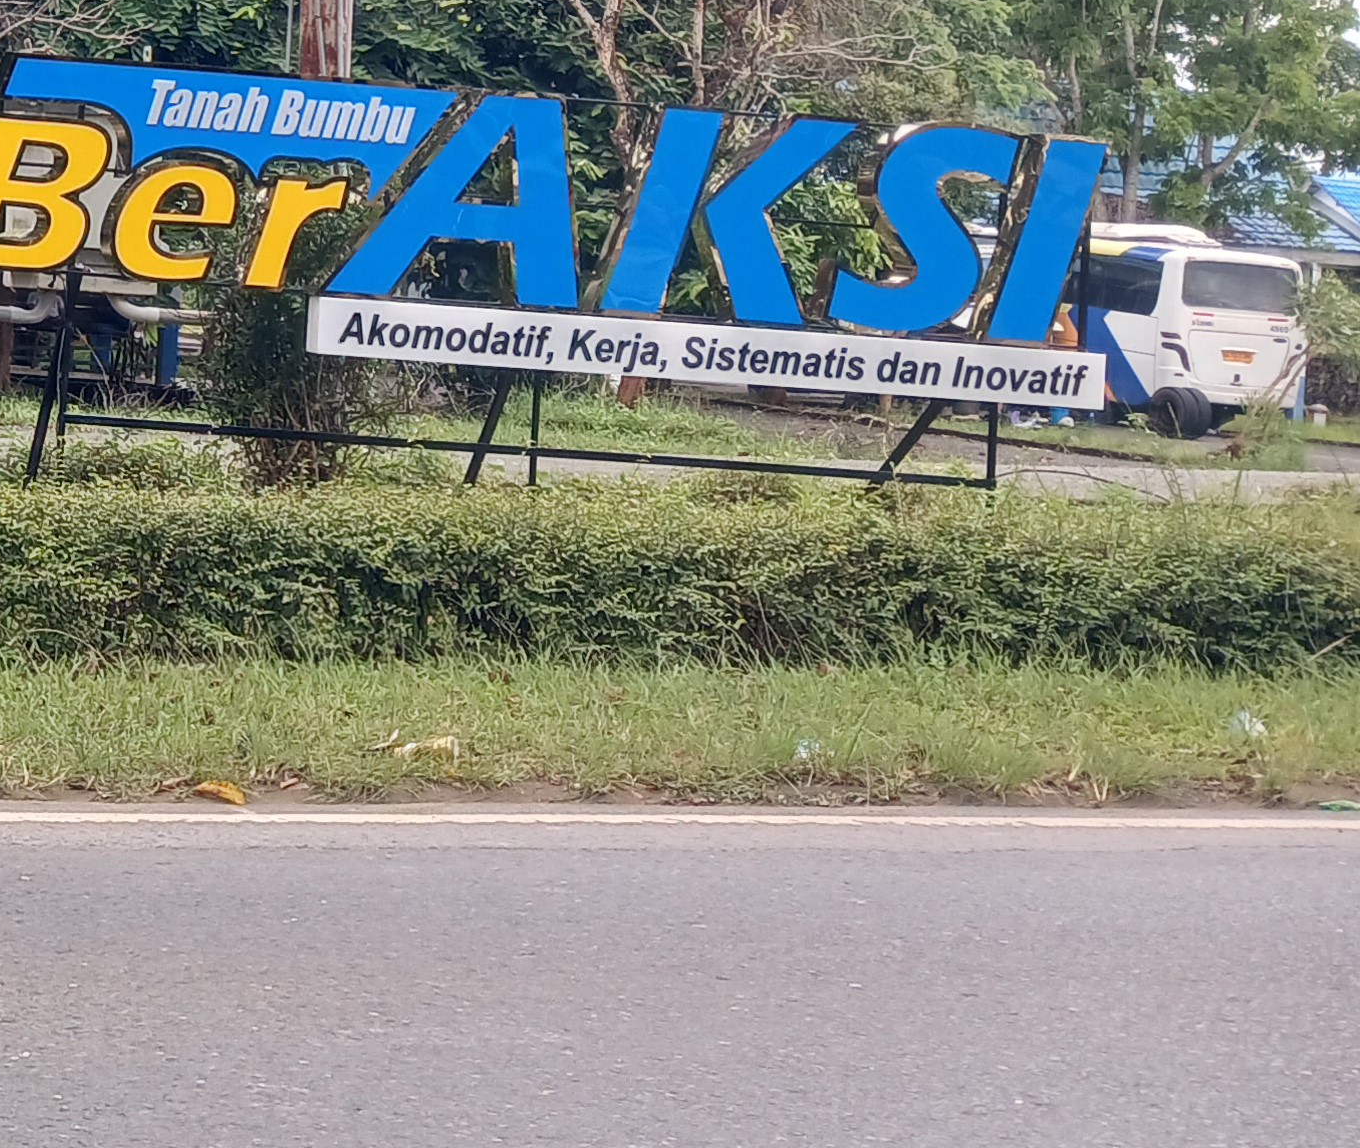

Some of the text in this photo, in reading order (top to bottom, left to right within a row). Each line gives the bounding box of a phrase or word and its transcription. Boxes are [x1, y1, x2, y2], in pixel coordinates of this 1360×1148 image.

[146, 79, 416, 144] Tanah Bumbu
[340, 312, 1088, 397] Akomodatif, Kerja, Sistematis dan Inovatif
